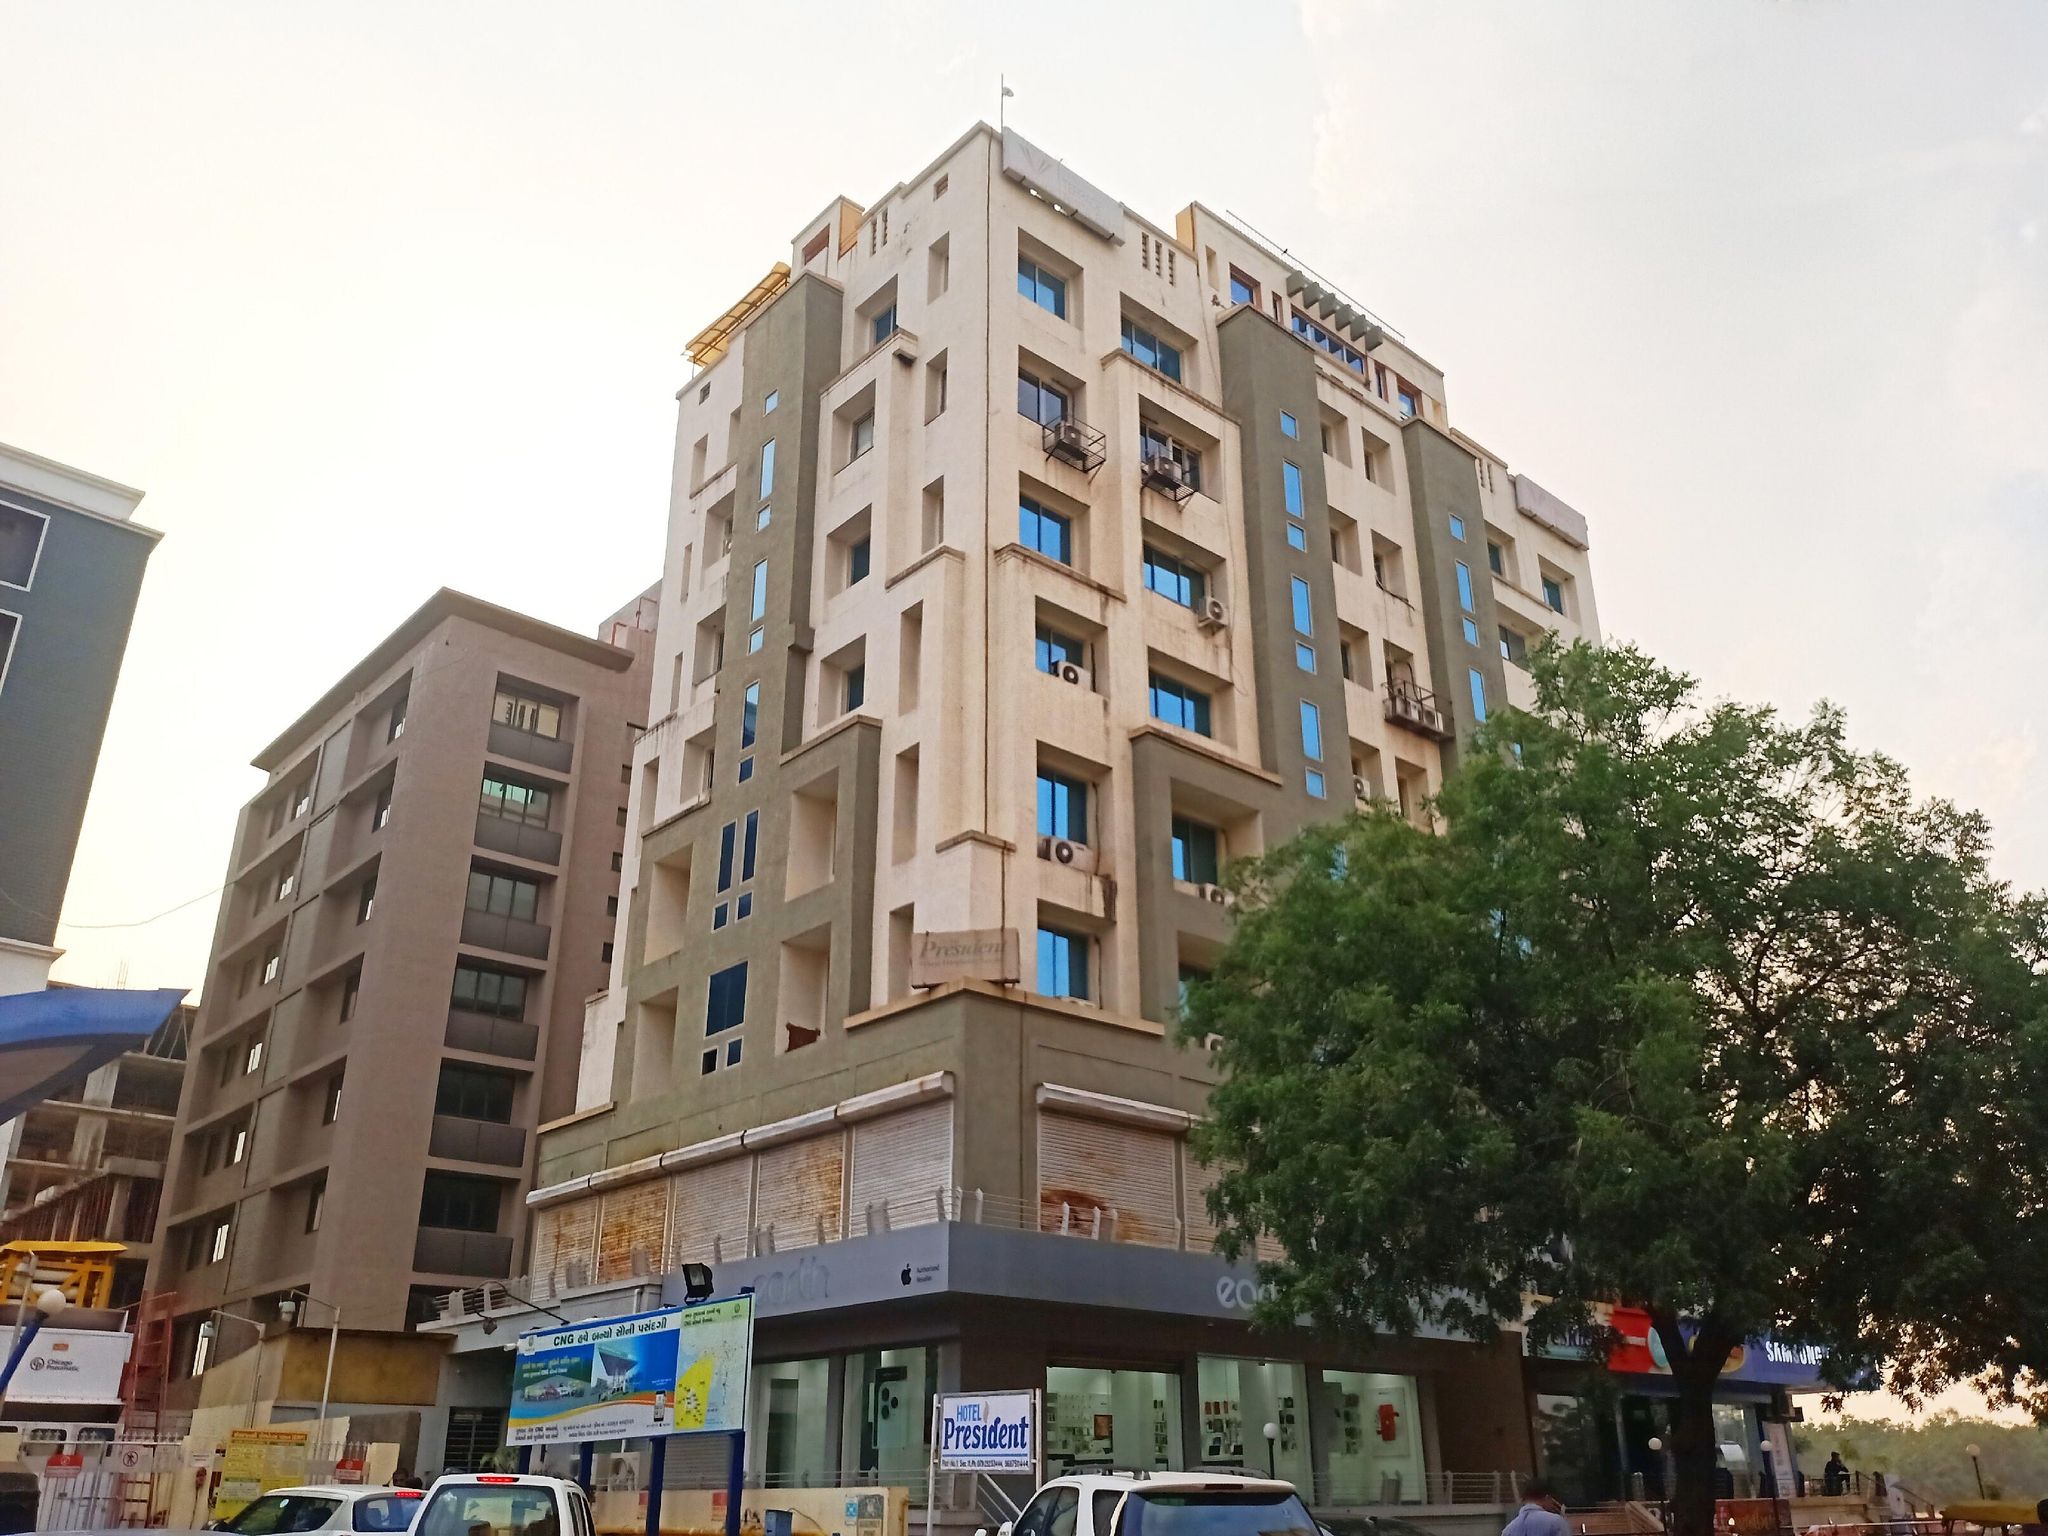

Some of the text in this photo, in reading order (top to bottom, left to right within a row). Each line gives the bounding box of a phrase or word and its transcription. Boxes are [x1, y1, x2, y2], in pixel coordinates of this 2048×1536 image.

[553, 1334, 574, 1346] CNG
[47, 1358, 73, 1366] Chicago
[956, 1404, 982, 1422] HOTEL
[942, 1416, 1029, 1450] President
